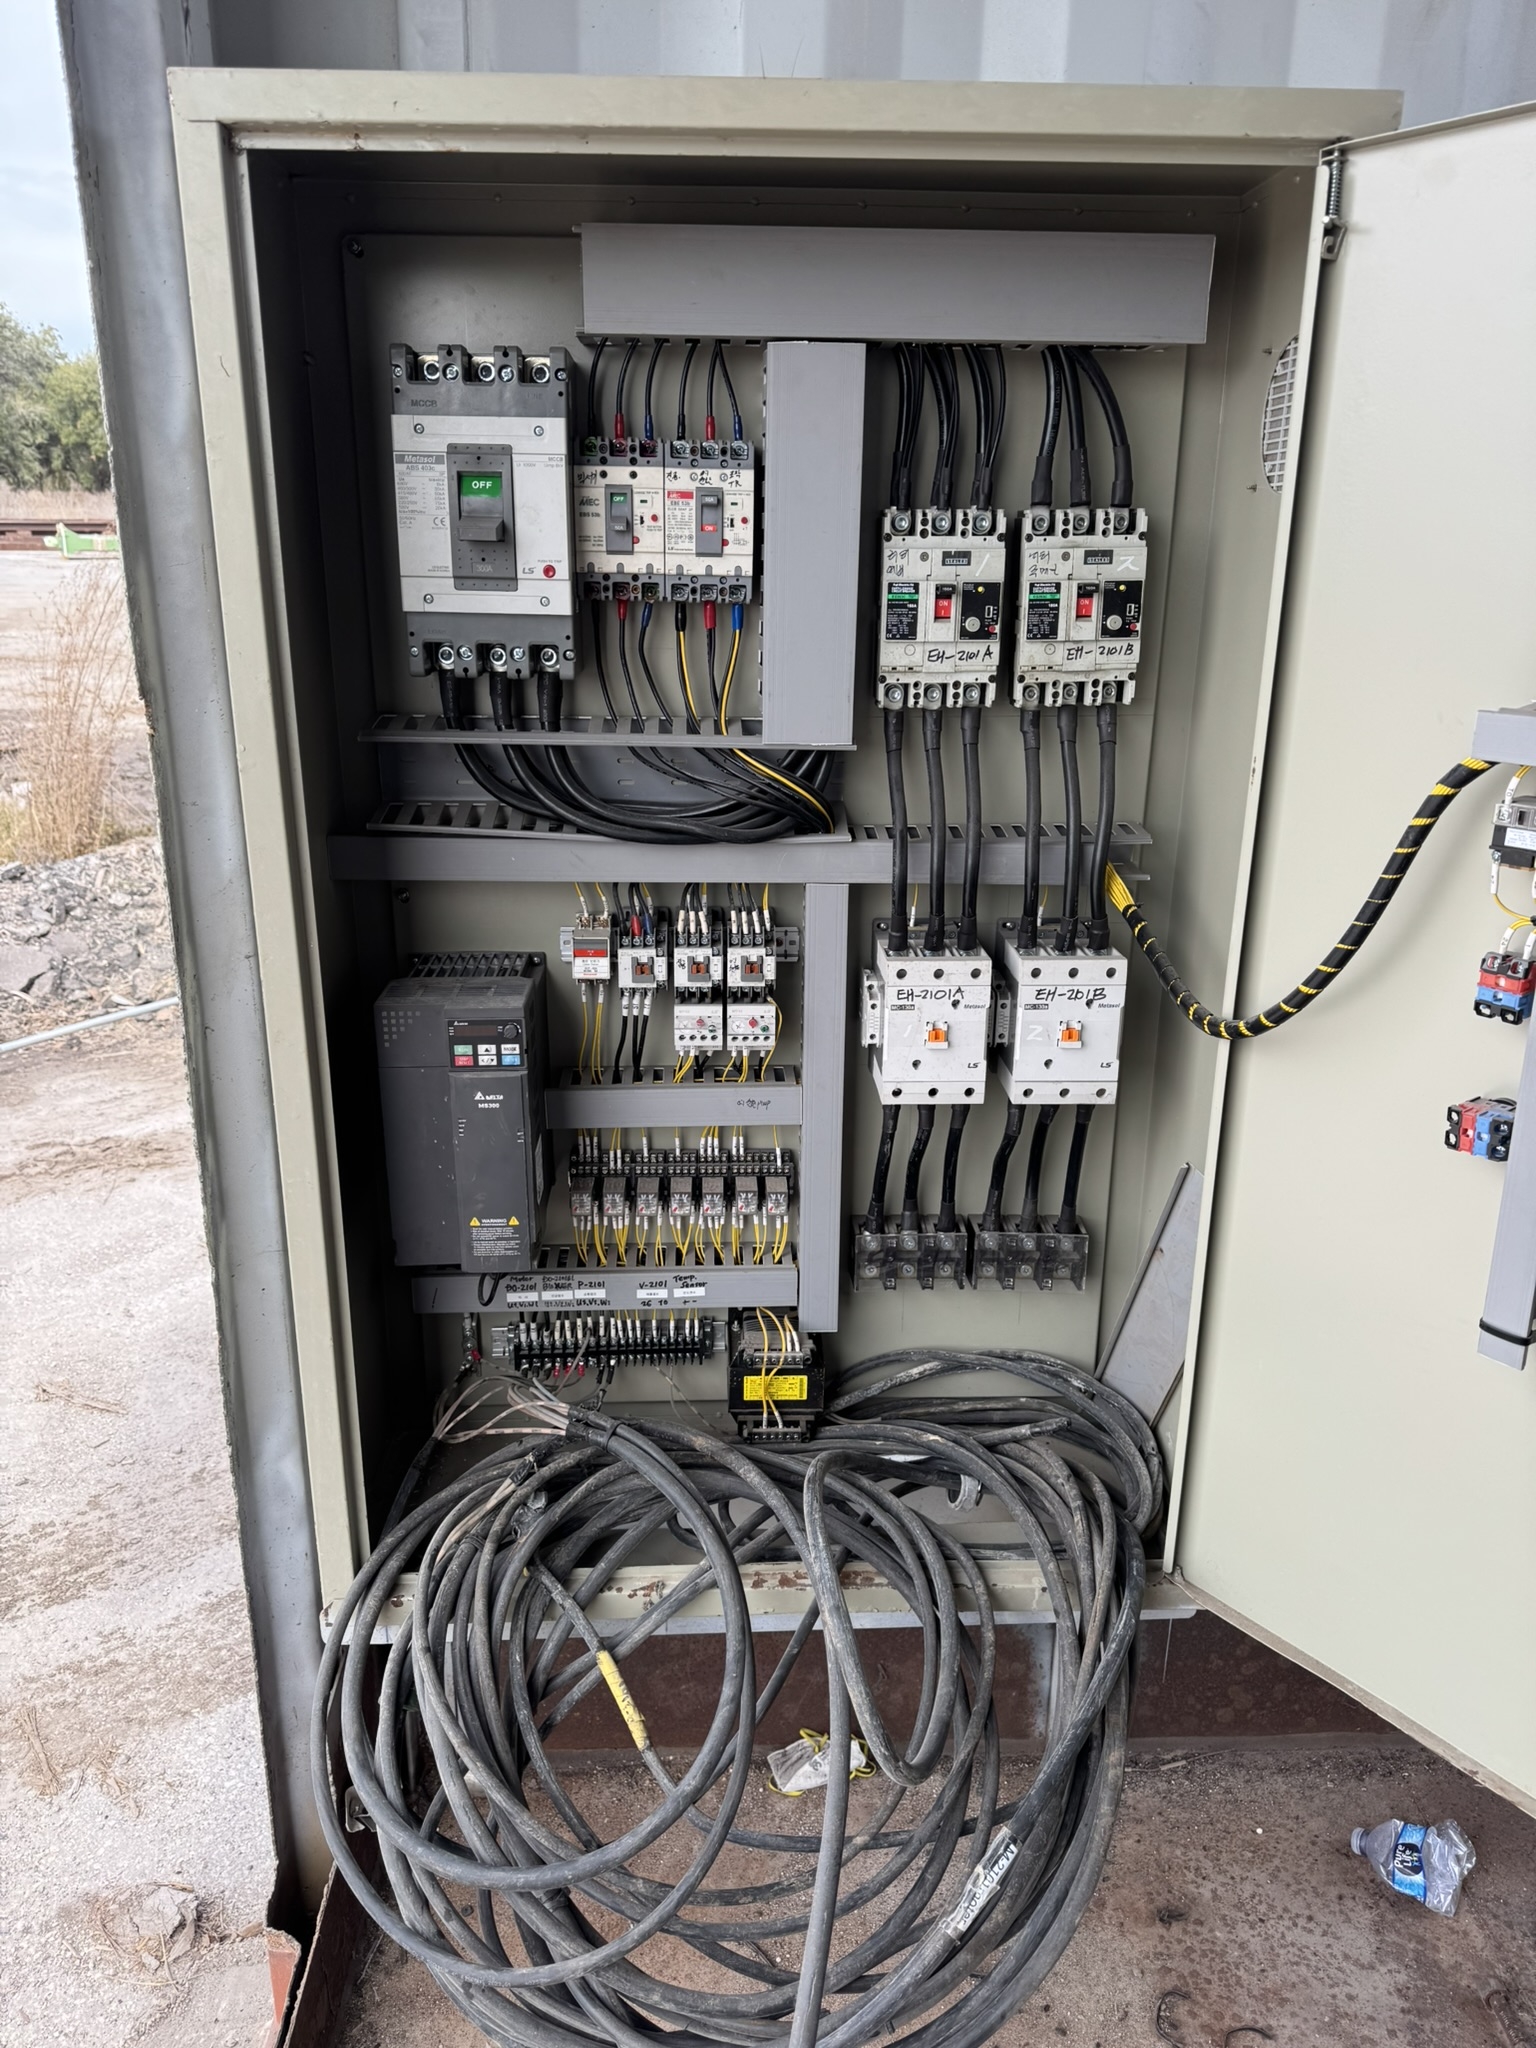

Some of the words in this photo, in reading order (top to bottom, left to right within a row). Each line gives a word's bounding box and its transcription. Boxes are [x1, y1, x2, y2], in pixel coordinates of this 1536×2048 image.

[411, 399, 438, 408] MCCB
[404, 455, 436, 464] Metasol
[472, 481, 492, 489] OFF
[897, 986, 965, 1002] EH-2101A
[578, 1281, 605, 1289] P-2101
[639, 1280, 667, 1289] V-2101
[1394, 1844, 1405, 1868] Pure
[1402, 1849, 1412, 1867] Life
